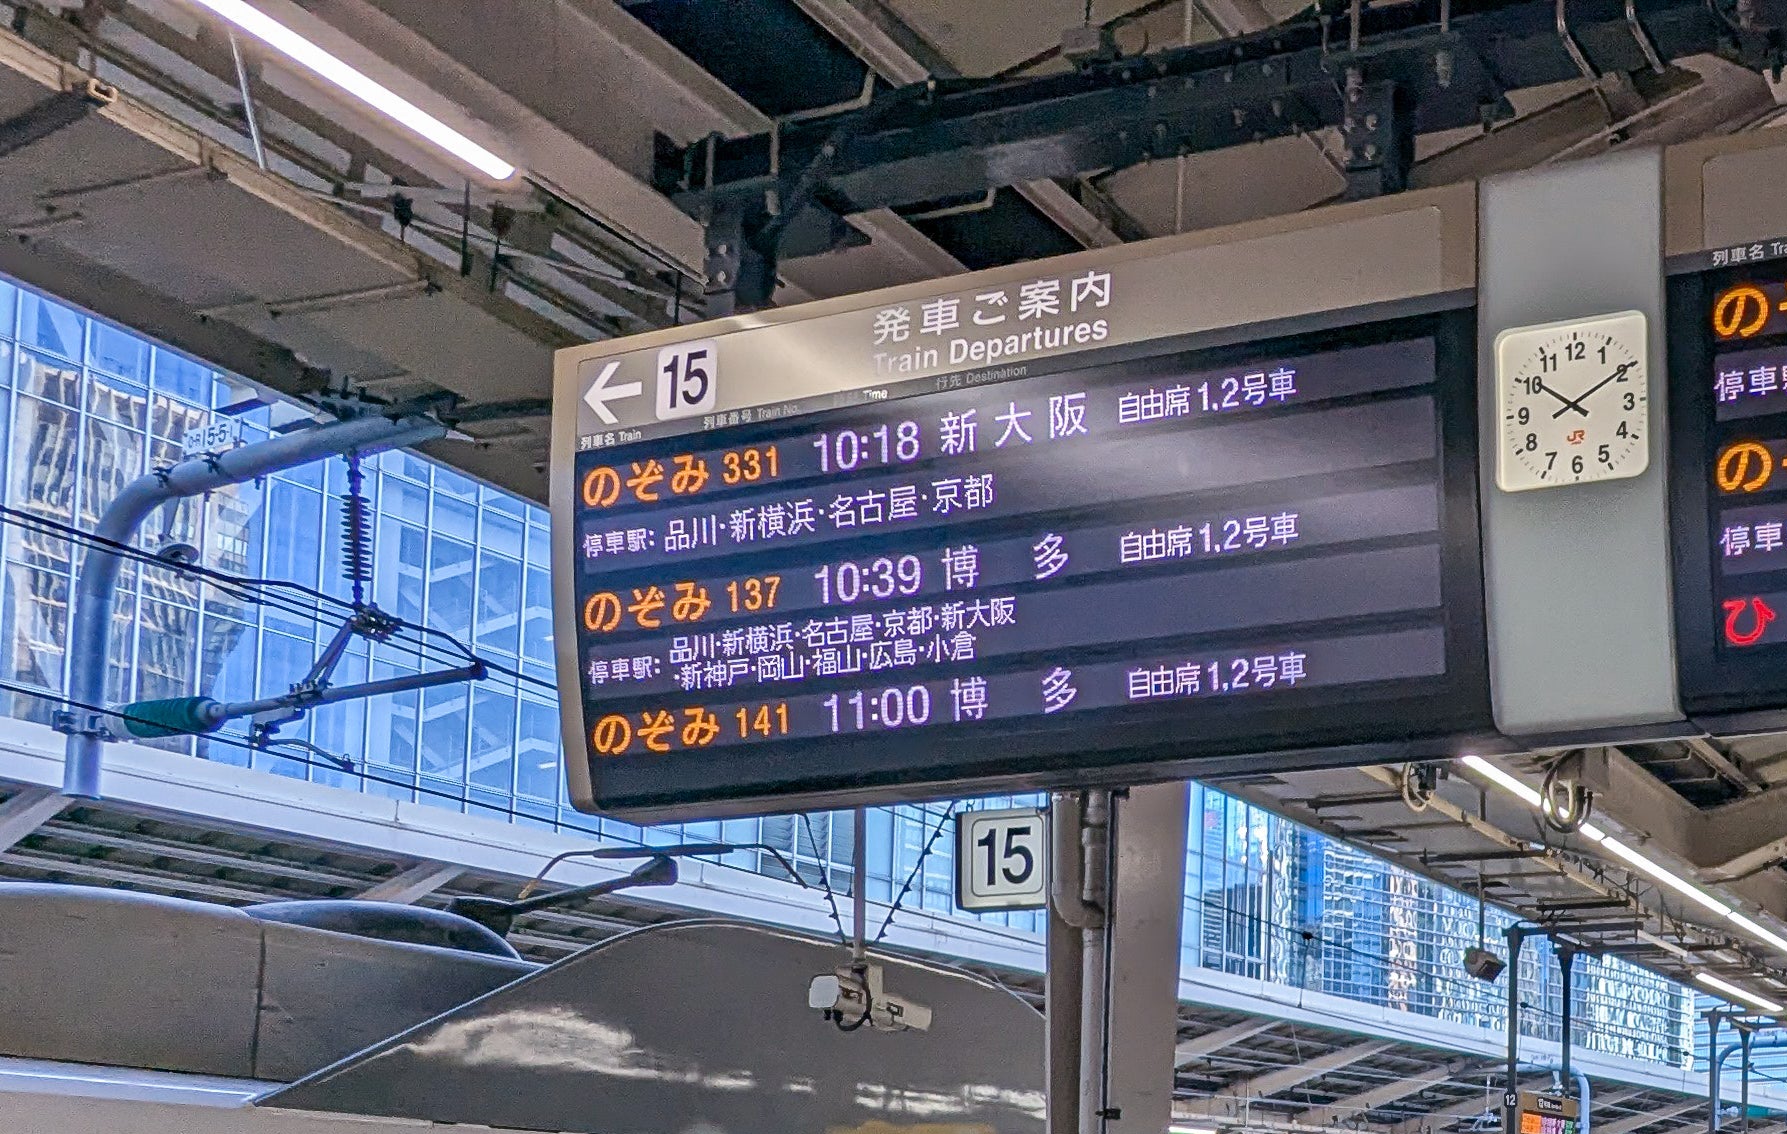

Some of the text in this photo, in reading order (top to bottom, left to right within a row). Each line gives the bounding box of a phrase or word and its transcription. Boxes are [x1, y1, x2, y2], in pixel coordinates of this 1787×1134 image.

[1712, 244, 1765, 267] 列車名
[873, 269, 1111, 346] 発車ご案内
[873, 317, 1108, 377] Train Departures
[1565, 341, 1585, 361] 12
[1597, 346, 1606, 364] 1
[1540, 353, 1557, 373] 11
[662, 350, 709, 409] 15
[966, 366, 1027, 384] Destination
[1616, 364, 1628, 383] 2
[862, 390, 888, 400] Time
[1524, 376, 1542, 395] 10
[1623, 392, 1635, 411] 3
[757, 406, 781, 420] Train
[783, 404, 800, 415] No.
[1518, 407, 1530, 425] 9
[580, 429, 642, 450] 列車名 Train
[1567, 430, 1585, 441] JR
[1616, 421, 1628, 439] 4
[1526, 433, 1537, 451] 8
[1545, 452, 1558, 470] 7
[1598, 444, 1610, 463] 5
[583, 454, 710, 508] のぞみ
[722, 445, 780, 485] 331
[814, 421, 920, 474] 10:18
[1572, 455, 1583, 474] 6
[584, 582, 712, 633] のぞみ
[727, 575, 781, 614] 137
[814, 555, 922, 605] 10:39
[594, 708, 720, 756] のぞみ
[736, 703, 790, 740] 141
[823, 685, 930, 733] 11:00
[978, 826, 1034, 886] 15
[1505, 1094, 1516, 1106] 12
